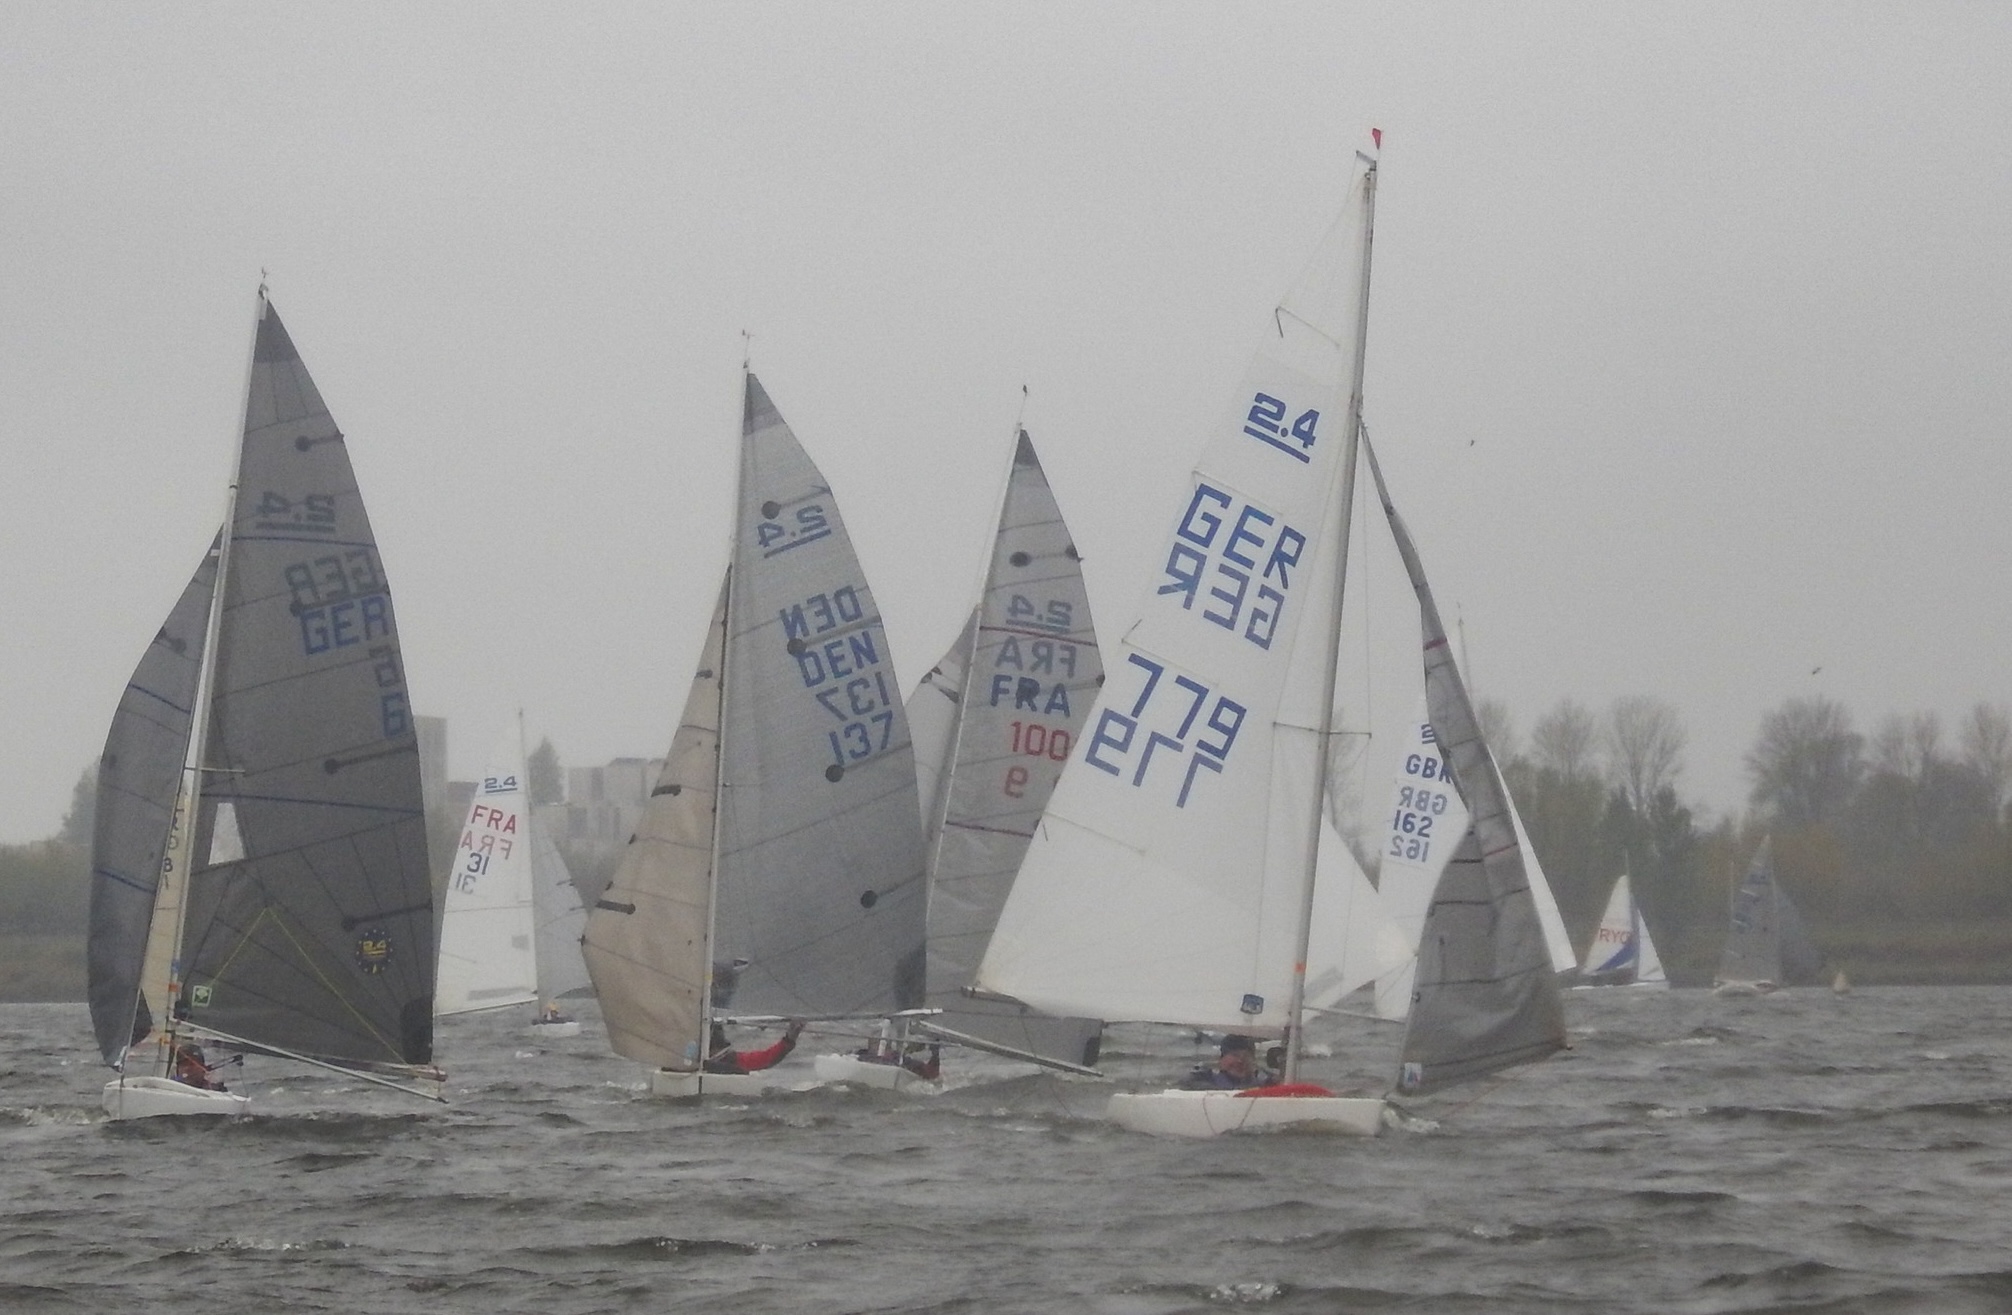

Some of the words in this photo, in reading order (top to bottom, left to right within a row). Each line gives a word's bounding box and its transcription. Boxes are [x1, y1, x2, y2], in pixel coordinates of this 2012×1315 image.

[1247, 392, 1320, 449] 2.4
[1177, 483, 1306, 589] GER
[301, 596, 389, 656] GER
[796, 631, 879, 688] DEN
[990, 674, 1070, 718] FRA
[1128, 653, 1246, 760] 779
[828, 710, 893, 766] 137
[484, 776, 517, 789] 2.4
[471, 805, 516, 834] FRA
[1393, 810, 1433, 838] 162
[467, 852, 489, 875] 31
